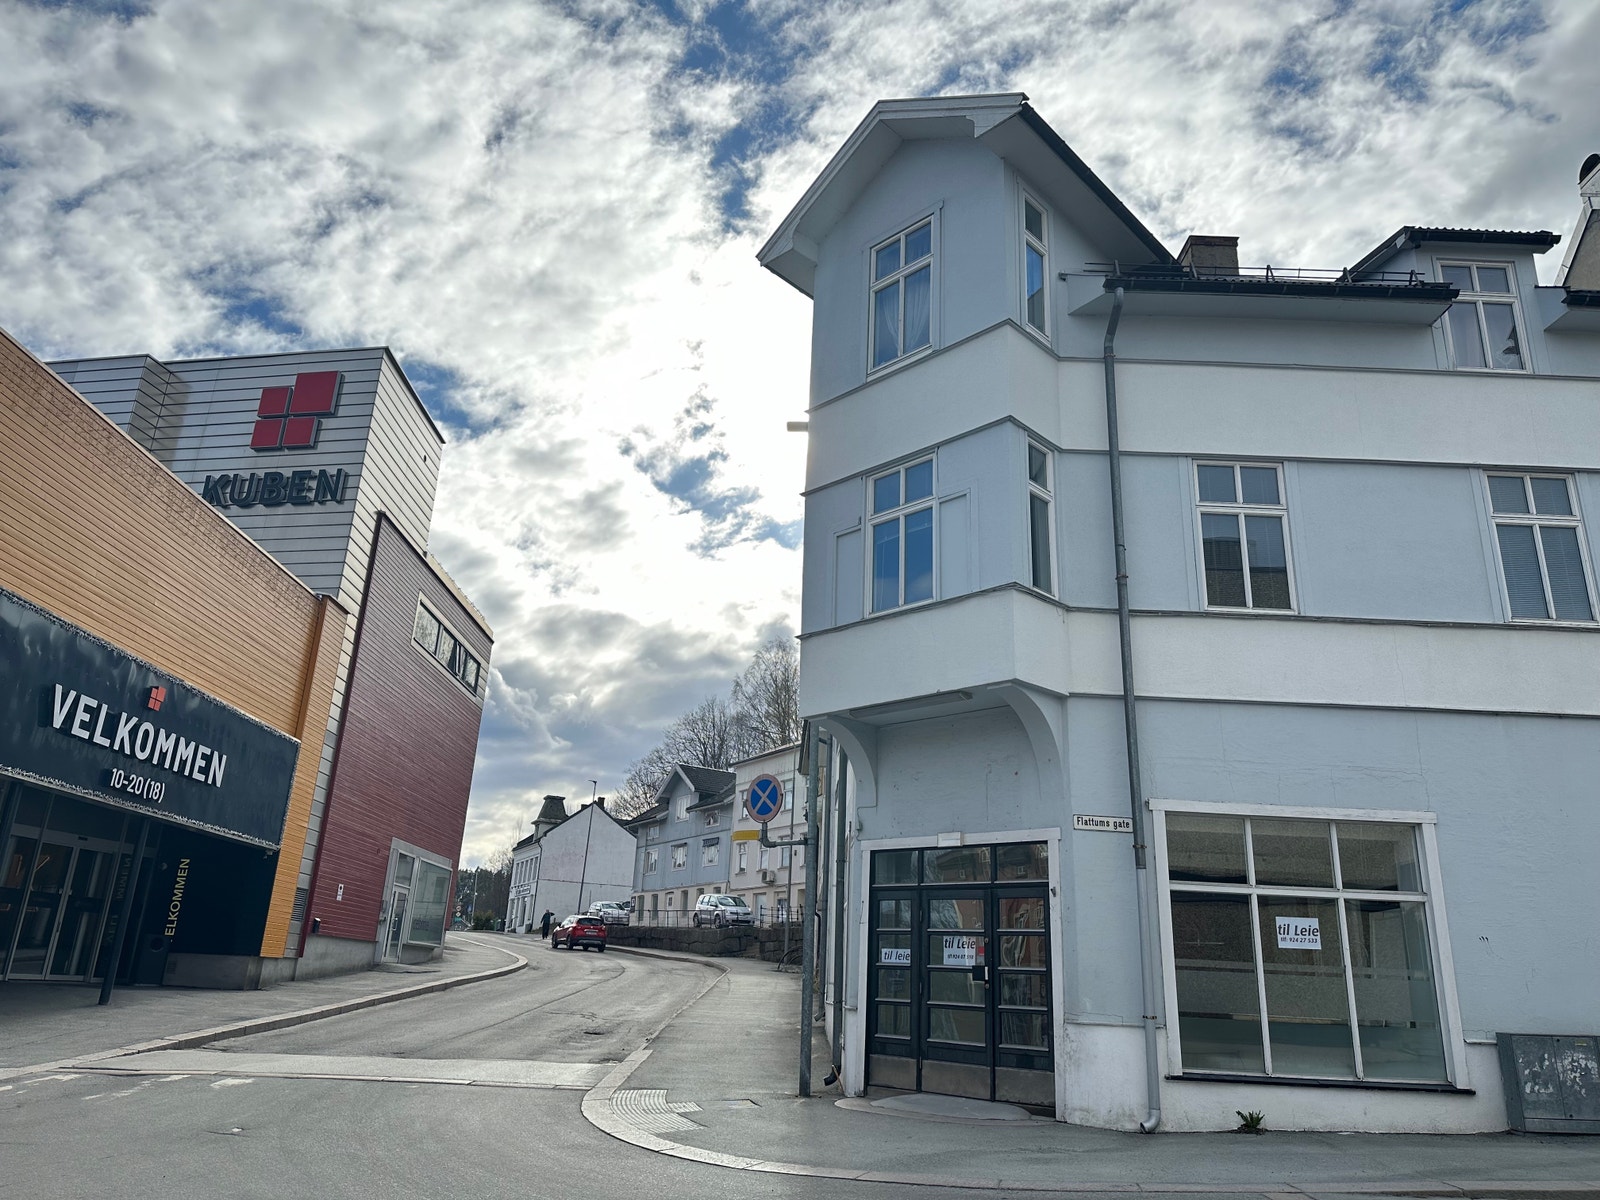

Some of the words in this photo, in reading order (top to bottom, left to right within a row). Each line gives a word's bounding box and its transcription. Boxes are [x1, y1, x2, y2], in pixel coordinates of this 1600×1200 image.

[202, 468, 346, 507] KUBEN
[52, 683, 227, 788] VELKOMMEN
[1076, 816, 1110, 827] Flattums
[1113, 820, 1130, 830] gate
[164, 858, 191, 943] ELKOMMEN
[1278, 923, 1290, 936] til
[1294, 925, 1319, 937] Leie
[944, 937, 955, 949] til
[957, 938, 976, 949] Leie
[883, 951, 893, 960] til
